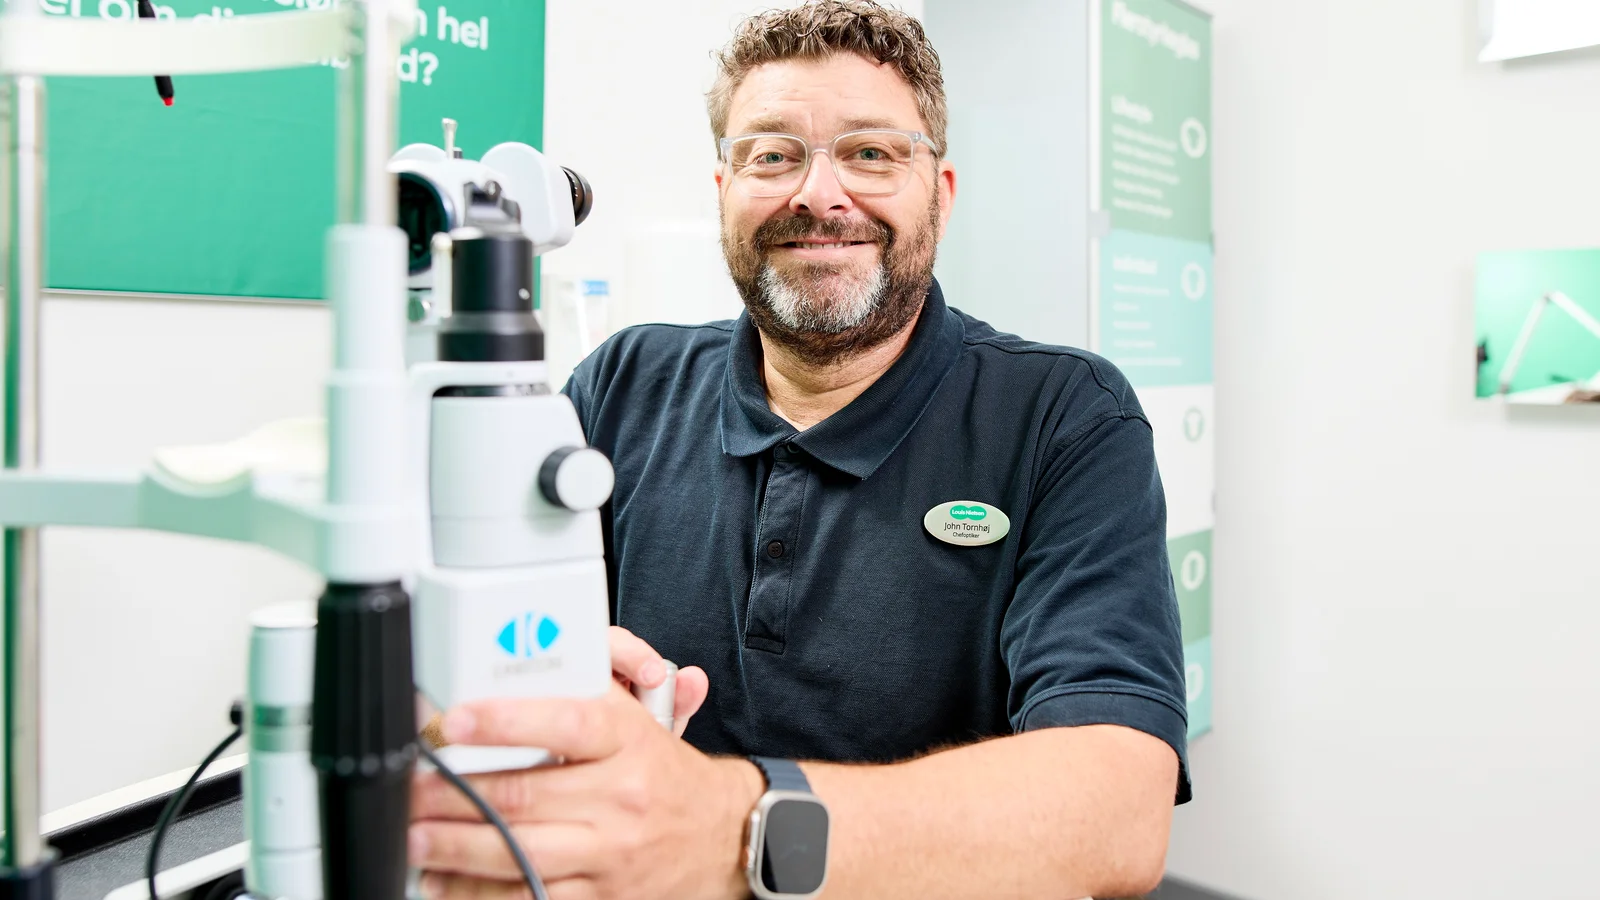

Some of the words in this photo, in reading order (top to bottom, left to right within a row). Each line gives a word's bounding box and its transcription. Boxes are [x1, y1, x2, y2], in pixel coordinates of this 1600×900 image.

[437, 6, 489, 51] hel
[944, 522, 961, 531] John
[962, 522, 990, 533] Tornhøj
